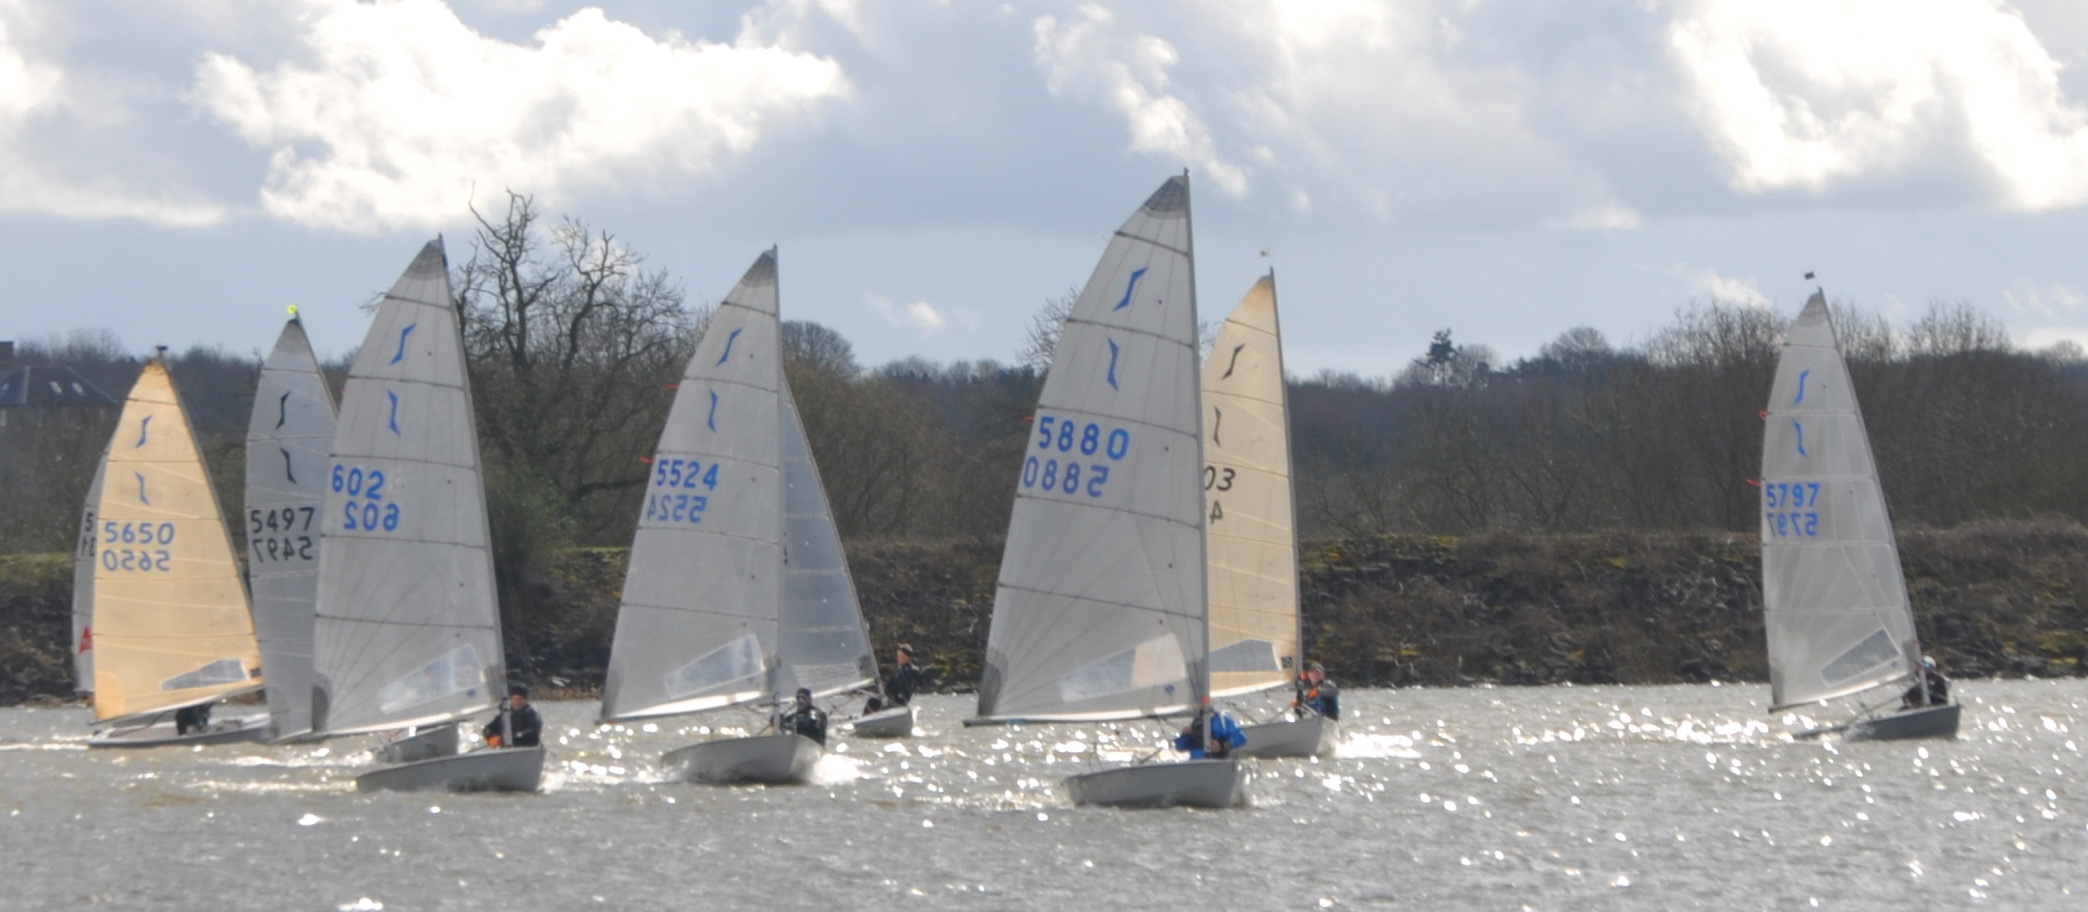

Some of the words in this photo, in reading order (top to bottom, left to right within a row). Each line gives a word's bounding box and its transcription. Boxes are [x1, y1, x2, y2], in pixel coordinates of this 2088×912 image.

[1038, 415, 1130, 461] 5880
[332, 463, 385, 500] 602
[656, 459, 719, 491] 5524
[1766, 482, 1821, 508] 5797
[104, 521, 175, 545] 5650
[251, 507, 315, 534] 5497
